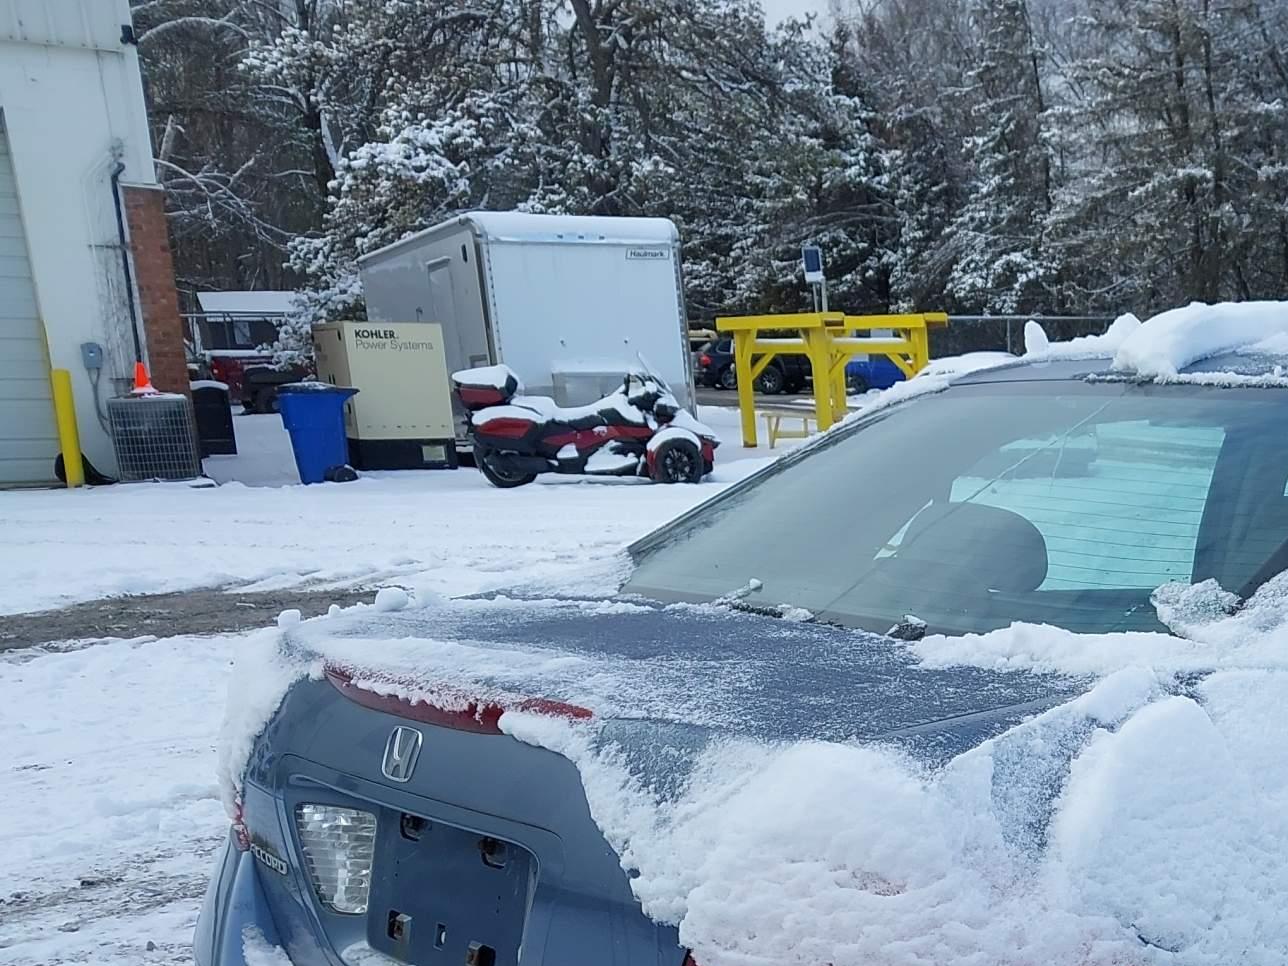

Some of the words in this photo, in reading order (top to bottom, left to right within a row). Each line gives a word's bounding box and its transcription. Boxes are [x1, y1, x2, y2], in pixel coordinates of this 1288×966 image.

[630, 249, 664, 257] Haulmark
[354, 329, 396, 339] KOHLER
[355, 340, 386, 350] Power
[390, 340, 433, 352] Systems
